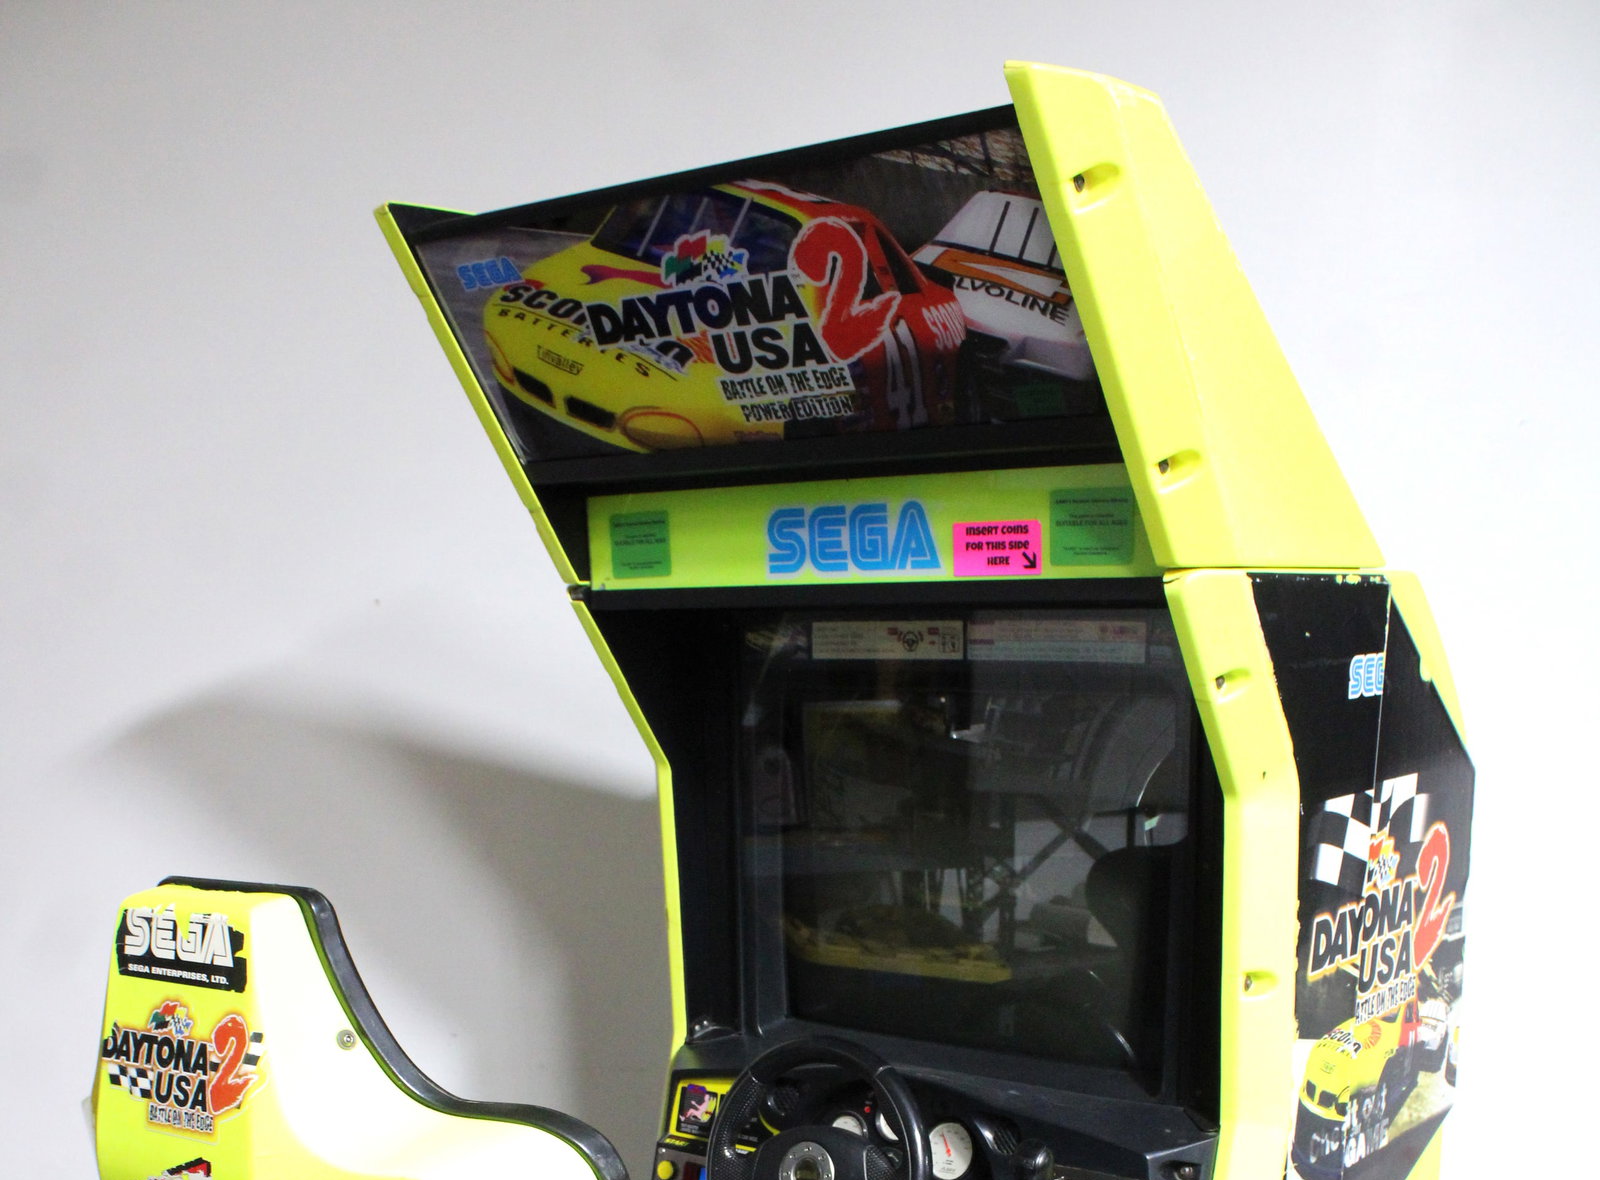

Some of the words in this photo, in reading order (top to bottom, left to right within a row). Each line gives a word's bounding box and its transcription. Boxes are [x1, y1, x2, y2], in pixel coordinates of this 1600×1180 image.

[457, 257, 524, 291] SEGA
[789, 218, 900, 363] 2
[586, 274, 809, 346] DAYTONA
[711, 322, 829, 375] USA
[720, 377, 767, 401] BATTLE
[766, 374, 789, 395] ON
[786, 371, 815, 394] THE
[812, 366, 850, 391] EDGE
[740, 402, 794, 422] POWER
[793, 396, 853, 420] EDITION
[767, 499, 943, 575] SEGA
[966, 541, 984, 551] FOR
[985, 540, 1007, 551] THIS
[987, 556, 1010, 566] HERE
[1414, 823, 1454, 969] 2
[125, 903, 234, 968] SEGA
[128, 963, 150, 974] SEGA
[151, 966, 210, 984] ENTERPRISES,
[211, 974, 229, 986] LTD.
[1358, 930, 1412, 994] USA
[1375, 993, 1387, 1014] ON
[1386, 986, 1398, 1011] THE
[1399, 976, 1416, 1002] EDGE
[102, 1027, 209, 1077] DAYTONA
[209, 1015, 257, 1115] 2
[154, 1070, 207, 1114] USA
[149, 1104, 172, 1123] BATTLE
[172, 1110, 182, 1126] ON
[183, 1112, 195, 1130] THE
[196, 1115, 214, 1133] EDGE
